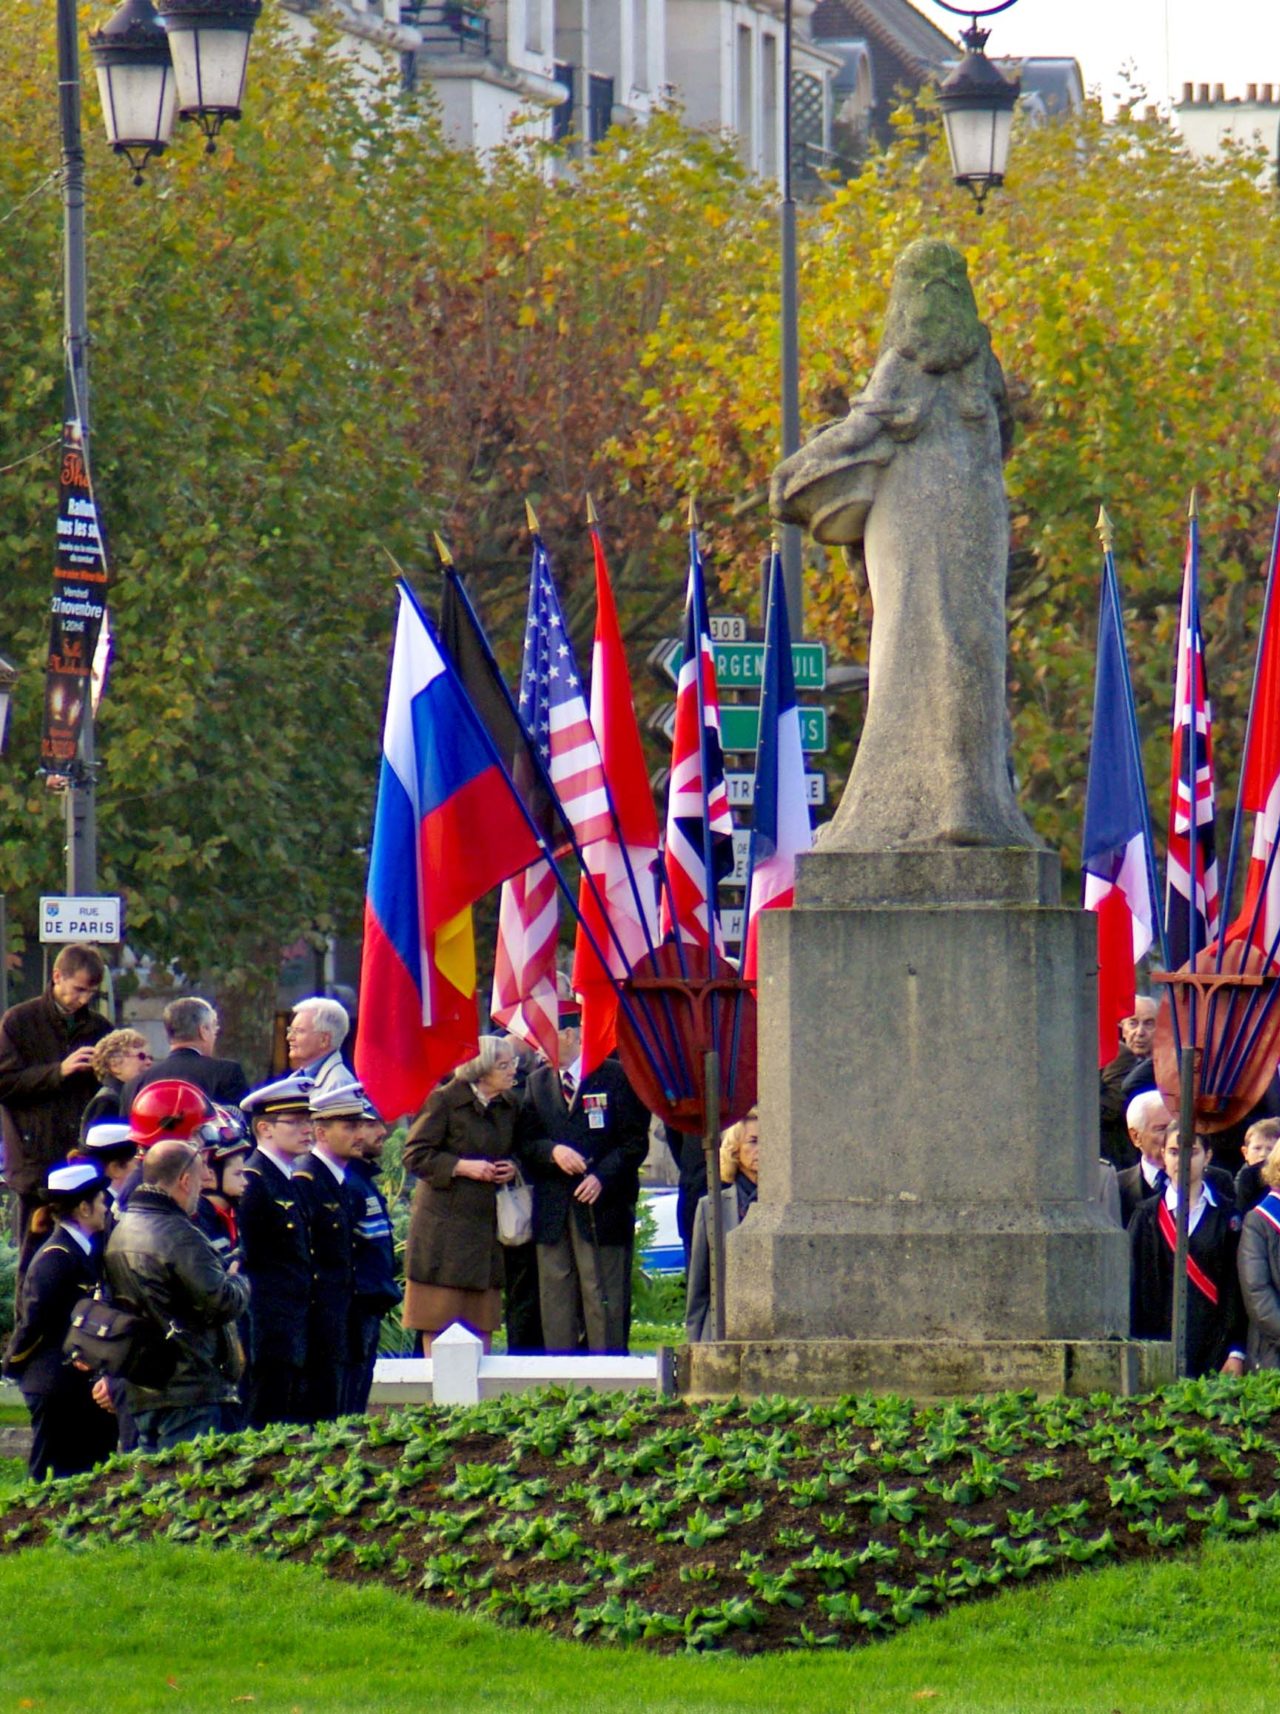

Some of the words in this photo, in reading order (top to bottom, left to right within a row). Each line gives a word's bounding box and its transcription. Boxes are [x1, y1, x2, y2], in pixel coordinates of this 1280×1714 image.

[51, 597, 61, 613] 27
[61, 599, 102, 618] novembre
[79, 907, 99, 916] RUE
[45, 921, 63, 933] DE
[69, 921, 114, 933] PARIS
